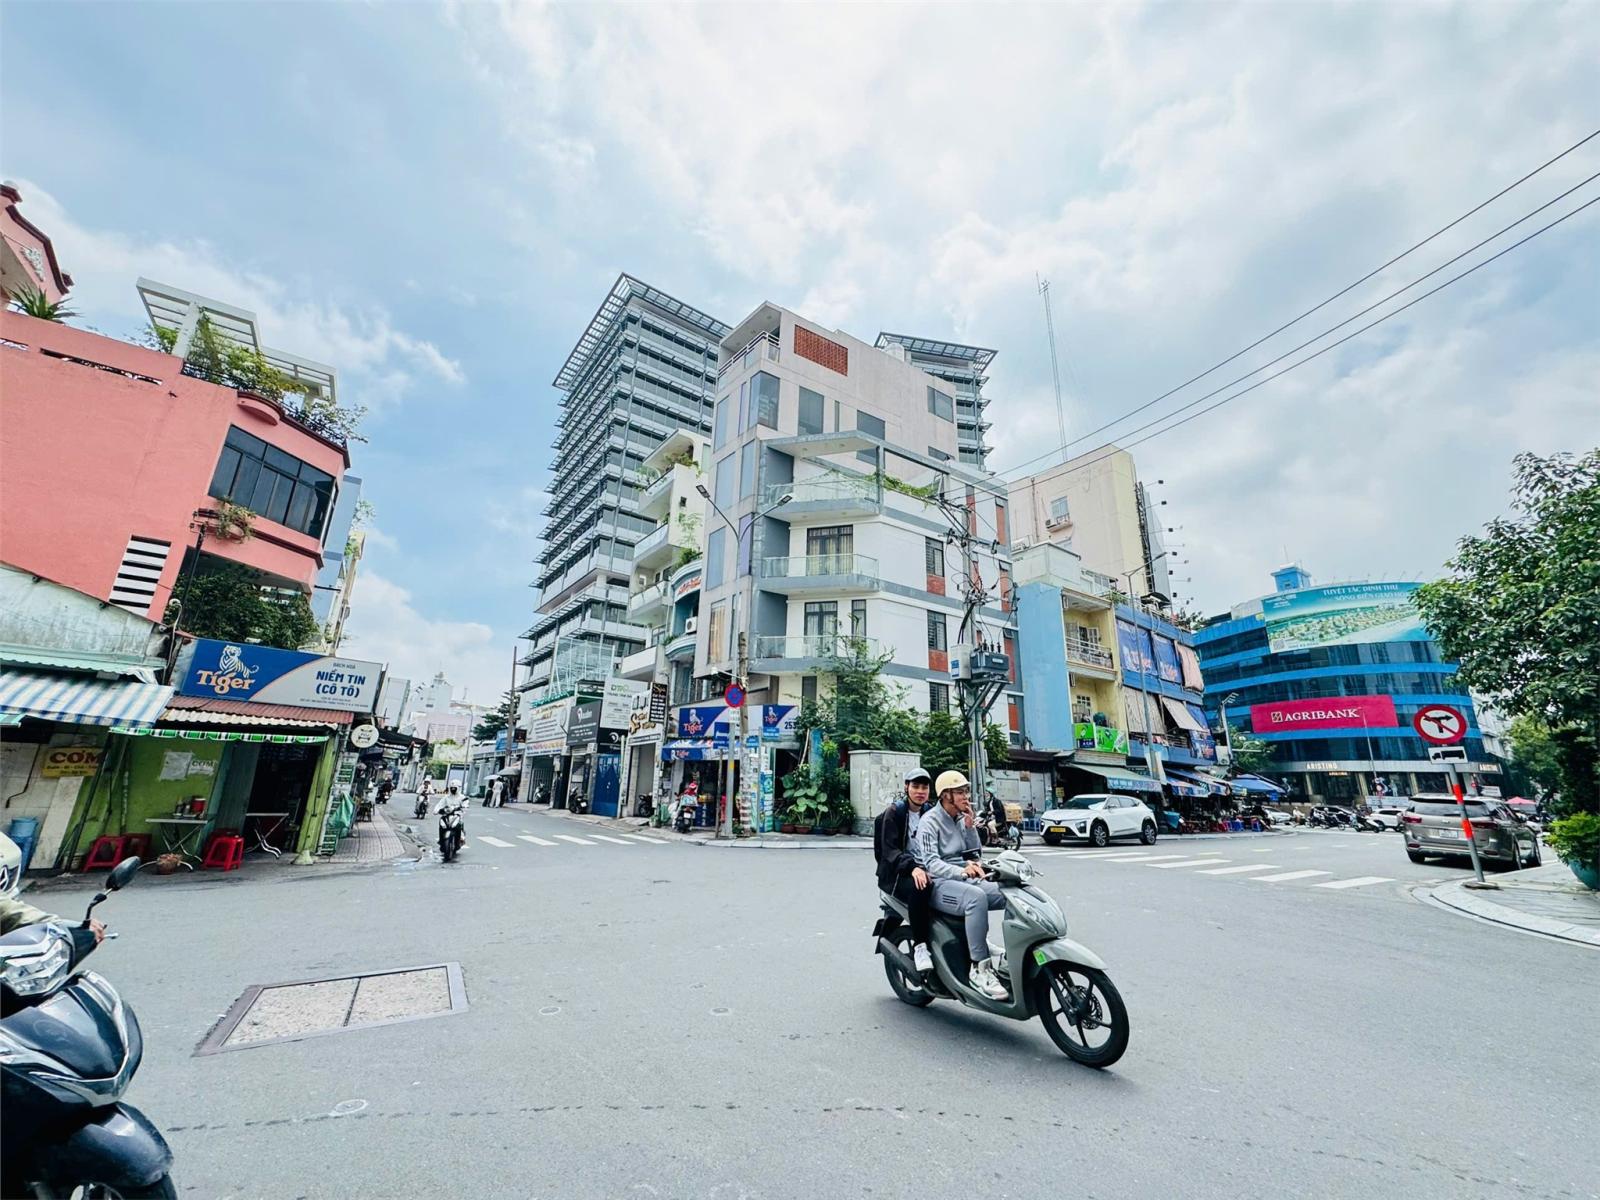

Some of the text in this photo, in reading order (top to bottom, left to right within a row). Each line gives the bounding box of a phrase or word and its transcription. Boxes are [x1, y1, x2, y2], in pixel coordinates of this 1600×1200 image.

[196, 669, 256, 695] Tiger
[347, 674, 367, 685] TIN
[315, 682, 360, 698] (CÔ TÔ)
[1284, 708, 1361, 722] AGRIBANK
[683, 722, 704, 735] Tiger
